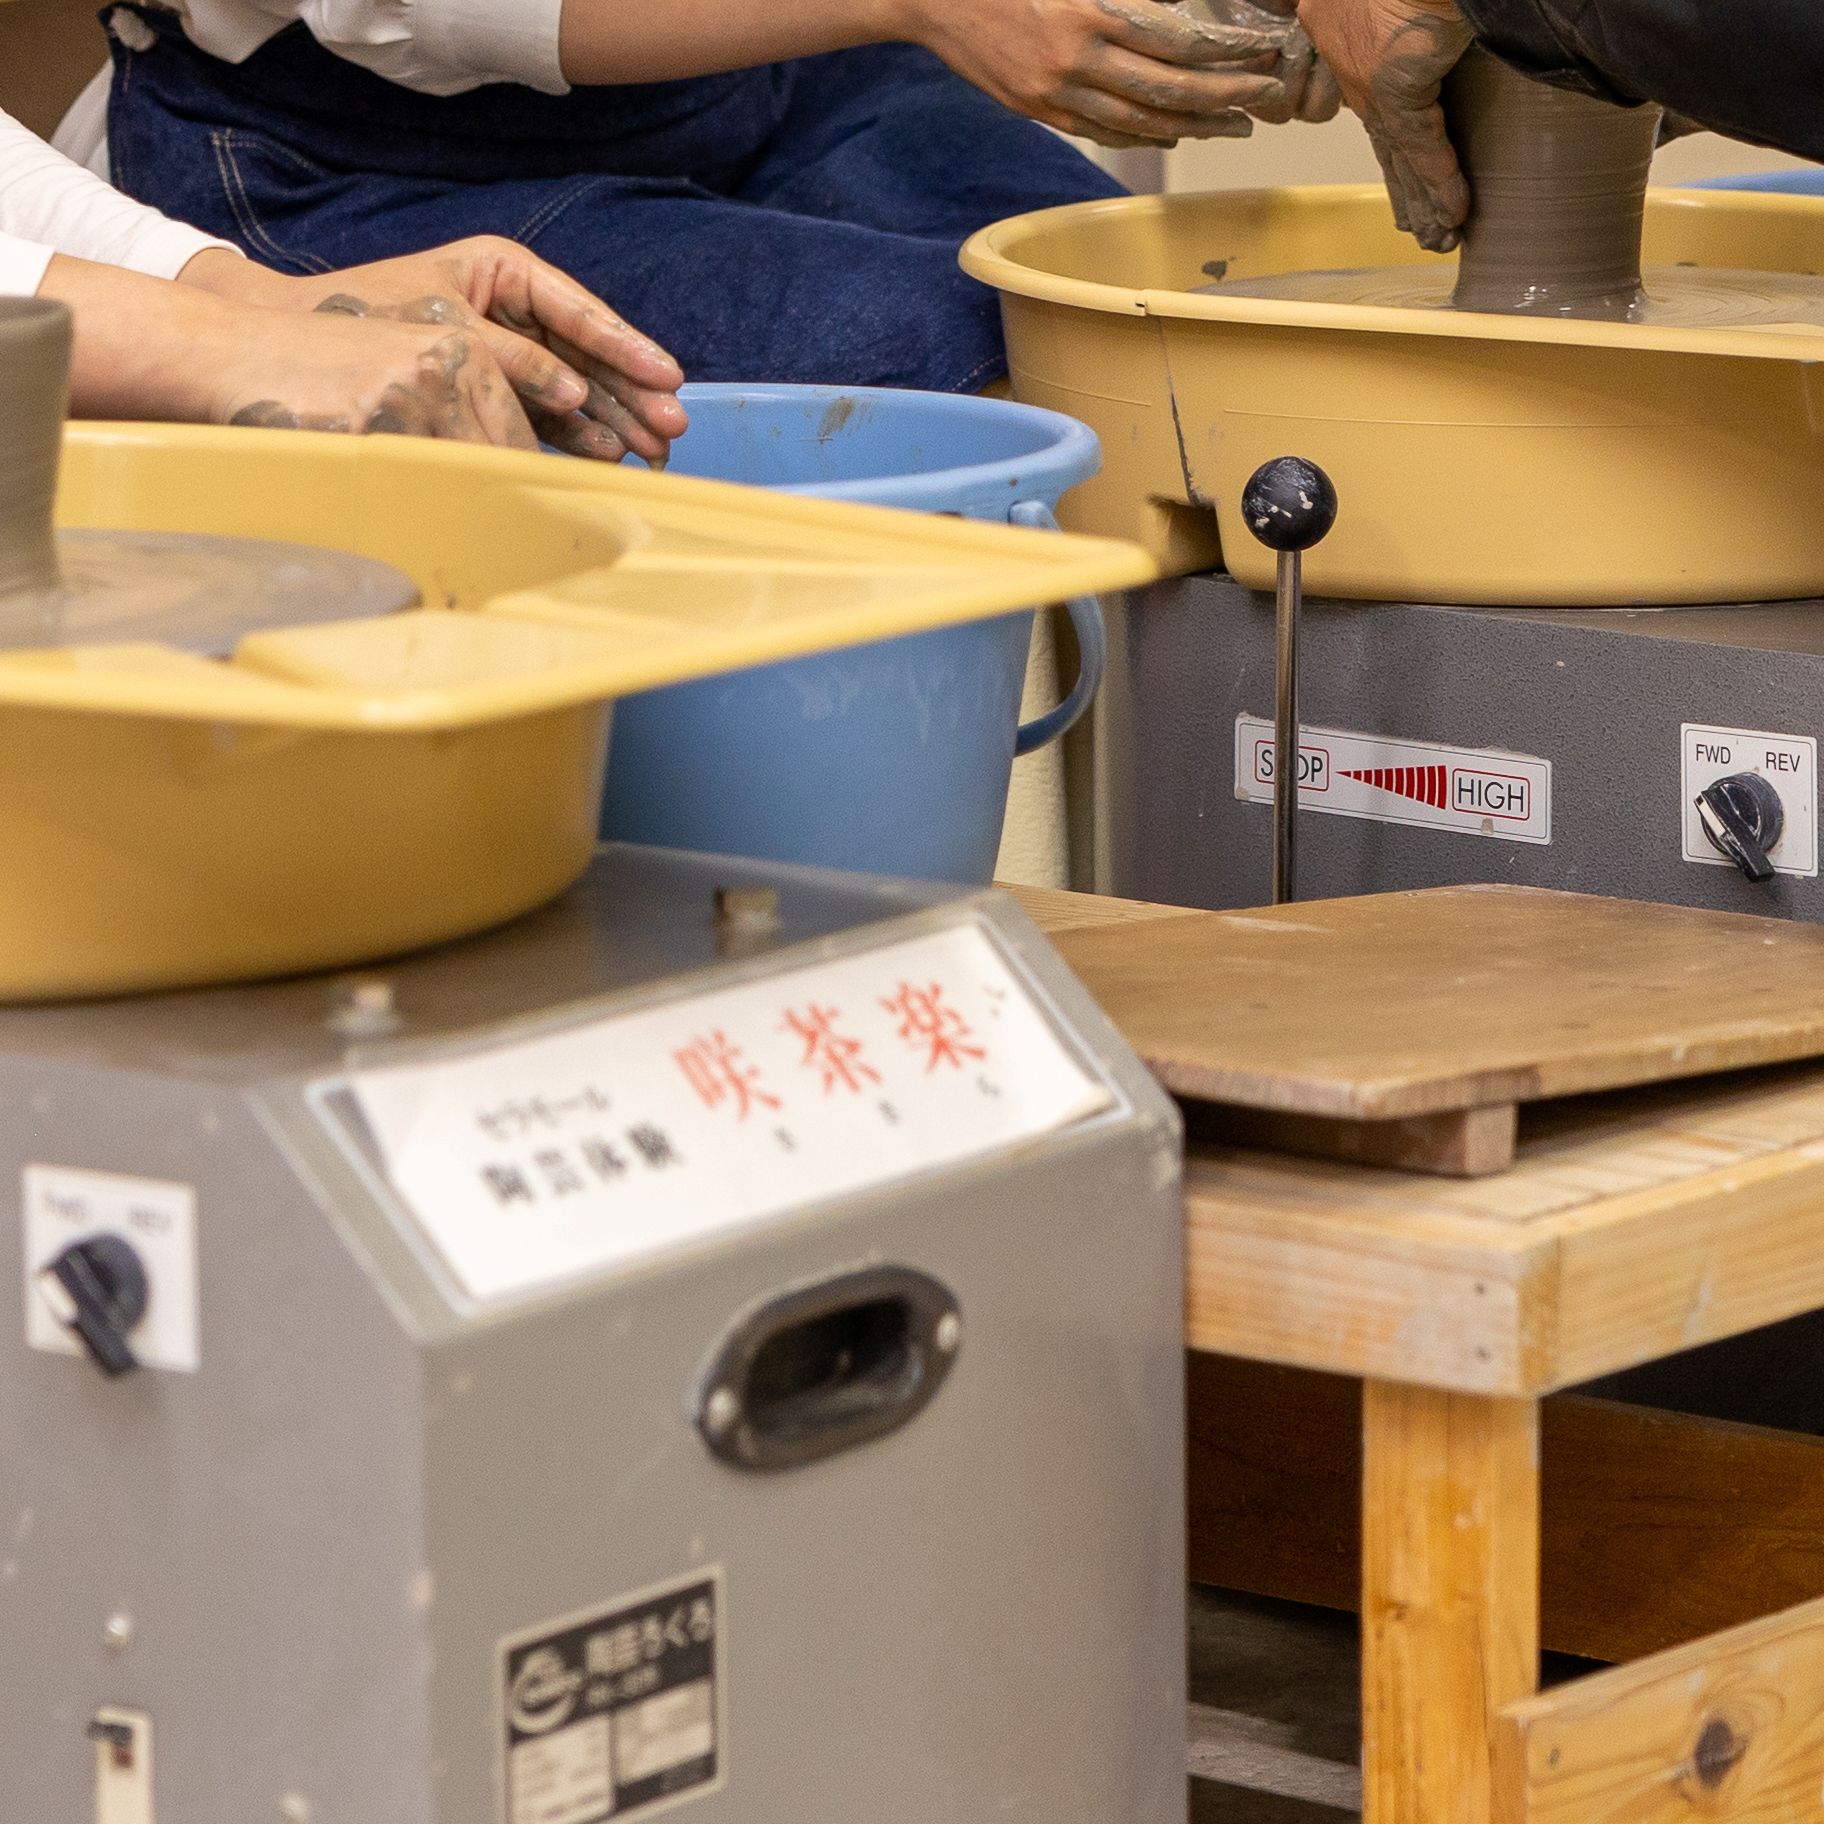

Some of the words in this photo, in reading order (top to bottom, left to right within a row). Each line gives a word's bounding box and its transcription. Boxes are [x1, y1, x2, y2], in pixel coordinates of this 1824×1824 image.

[1260, 748, 1324, 783] SOP
[1457, 776, 1525, 813] HIGH
[1695, 743, 1732, 765] FWD
[1765, 751, 1801, 773] REV
